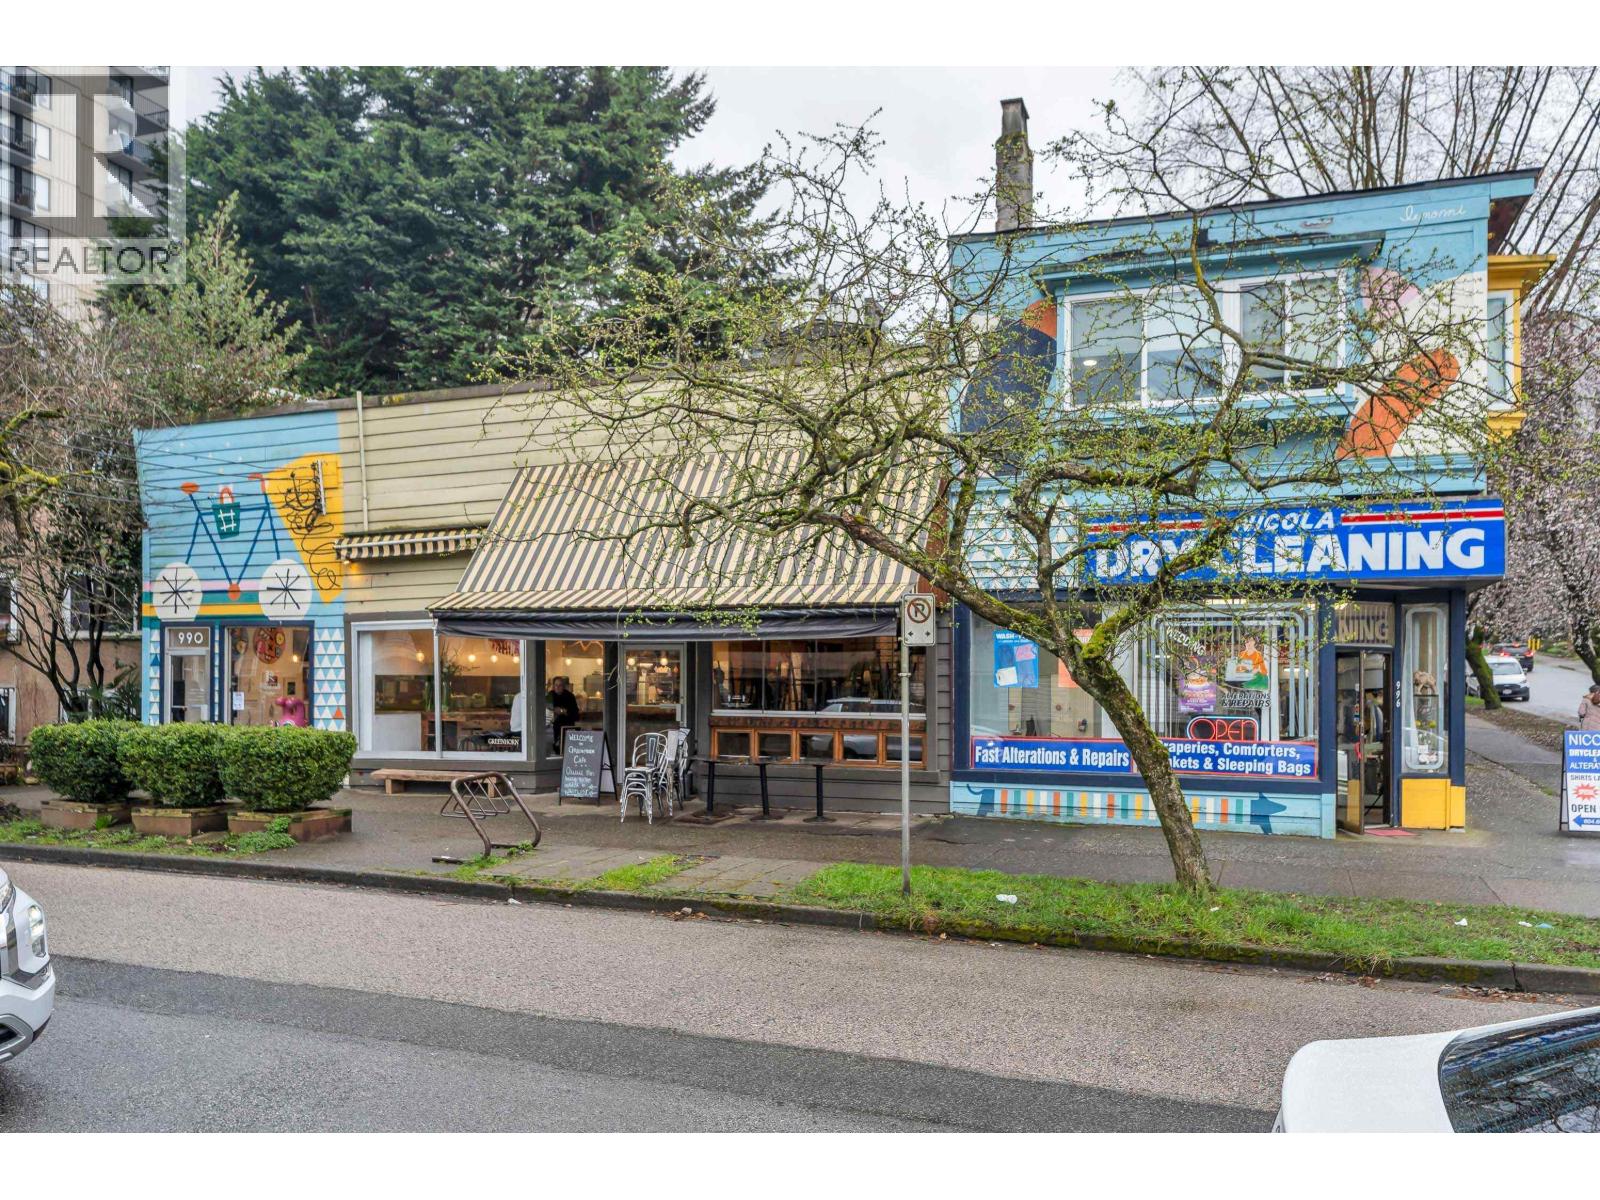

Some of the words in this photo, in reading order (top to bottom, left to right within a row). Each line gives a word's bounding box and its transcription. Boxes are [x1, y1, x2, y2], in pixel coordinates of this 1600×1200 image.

[178, 632, 204, 644] 990
[1231, 699, 1271, 708] REPAIRS
[975, 745, 1000, 763] Fast
[1002, 746, 1066, 765] Alterations
[1069, 748, 1079, 766] &
[1082, 749, 1129, 768] Repairs
[1223, 743, 1300, 760] Comforters,
[1203, 757, 1214, 770] &
[1217, 759, 1273, 775] Sleeping
[1278, 761, 1311, 776] Bags
[1571, 804, 1597, 813] OPEN
